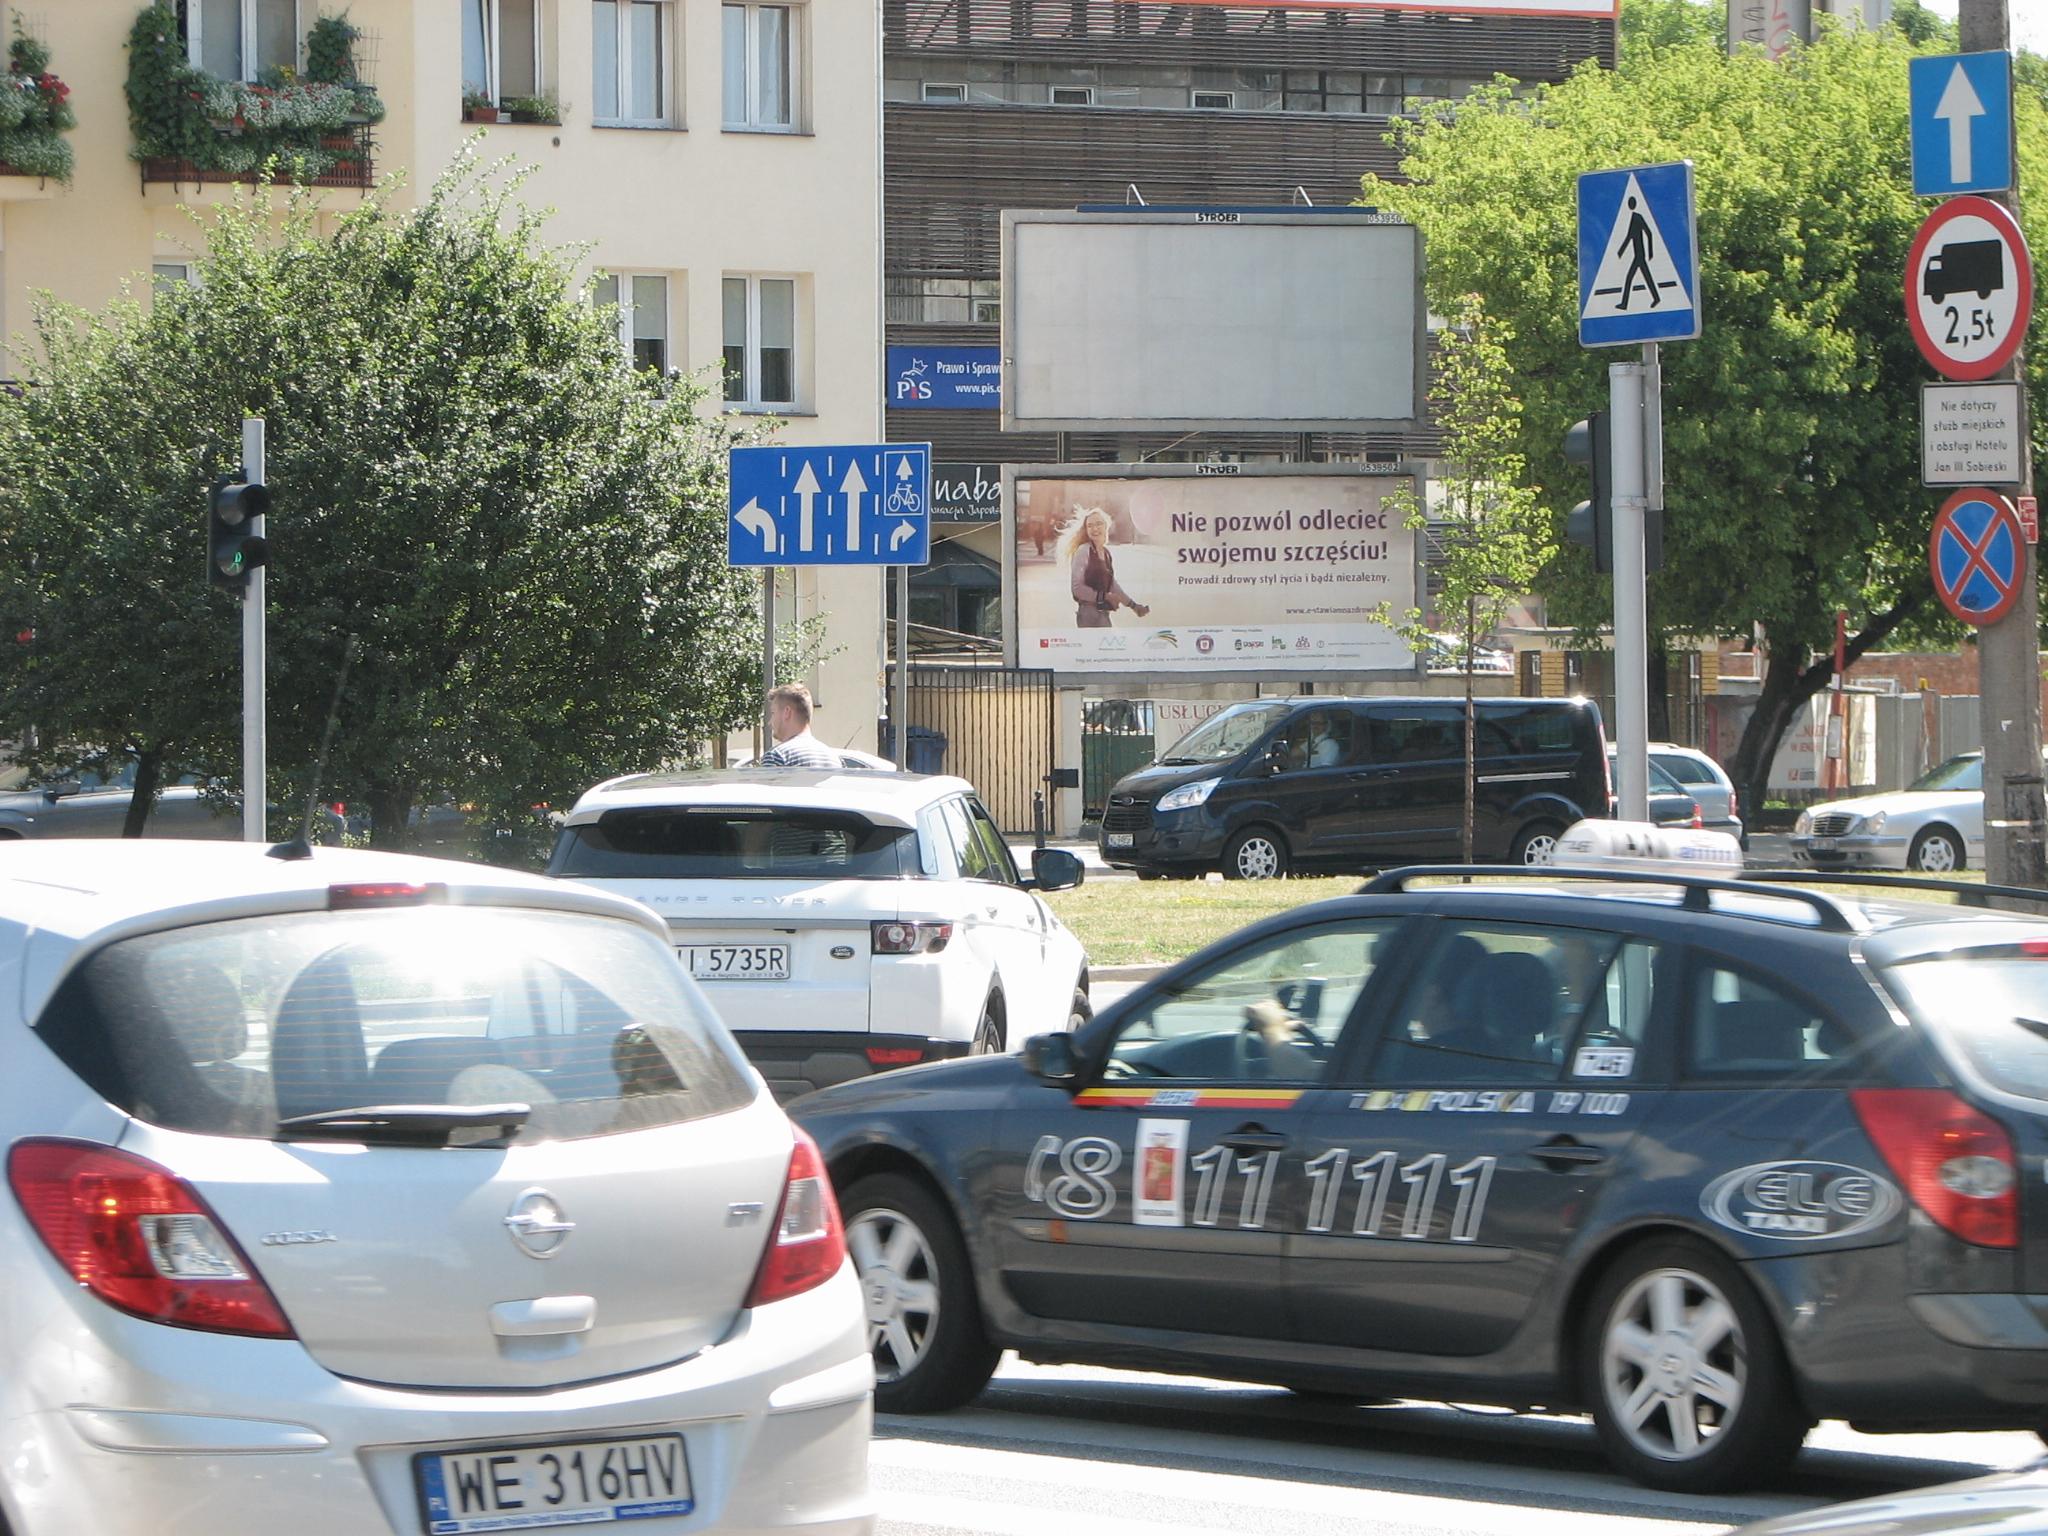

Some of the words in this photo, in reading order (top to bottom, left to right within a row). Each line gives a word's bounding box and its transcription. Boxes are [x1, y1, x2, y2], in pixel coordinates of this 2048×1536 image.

[1944, 305, 1995, 348] 2,5t
[936, 361, 965, 374] Prawo
[966, 361, 970, 374] i
[896, 380, 933, 400] PiS
[1941, 401, 1957, 412] Nie
[1960, 400, 1998, 413] dotyczy
[1961, 418, 2006, 432] miejskich
[1975, 439, 2008, 451] Hotelu
[1934, 461, 1951, 472] Jan
[1954, 461, 1963, 472] III
[1966, 460, 2008, 472] Sobieski
[1171, 512, 1208, 533] Nie
[1213, 510, 1291, 537] pozwól
[1299, 509, 1388, 531] odlecieć
[1177, 542, 1277, 568] swojemu
[1283, 540, 1388, 565] szczęściu!
[1178, 575, 1219, 585] Prowadź
[1221, 574, 1257, 586] zdrowy
[1259, 573, 1277, 585] styl
[709, 948, 784, 973] 5735R
[1303, 1147, 1498, 1242] 1111
[1743, 1170, 1873, 1217] ELE
[453, 1455, 524, 1514] WE
[538, 1442, 677, 1506] 316HV
